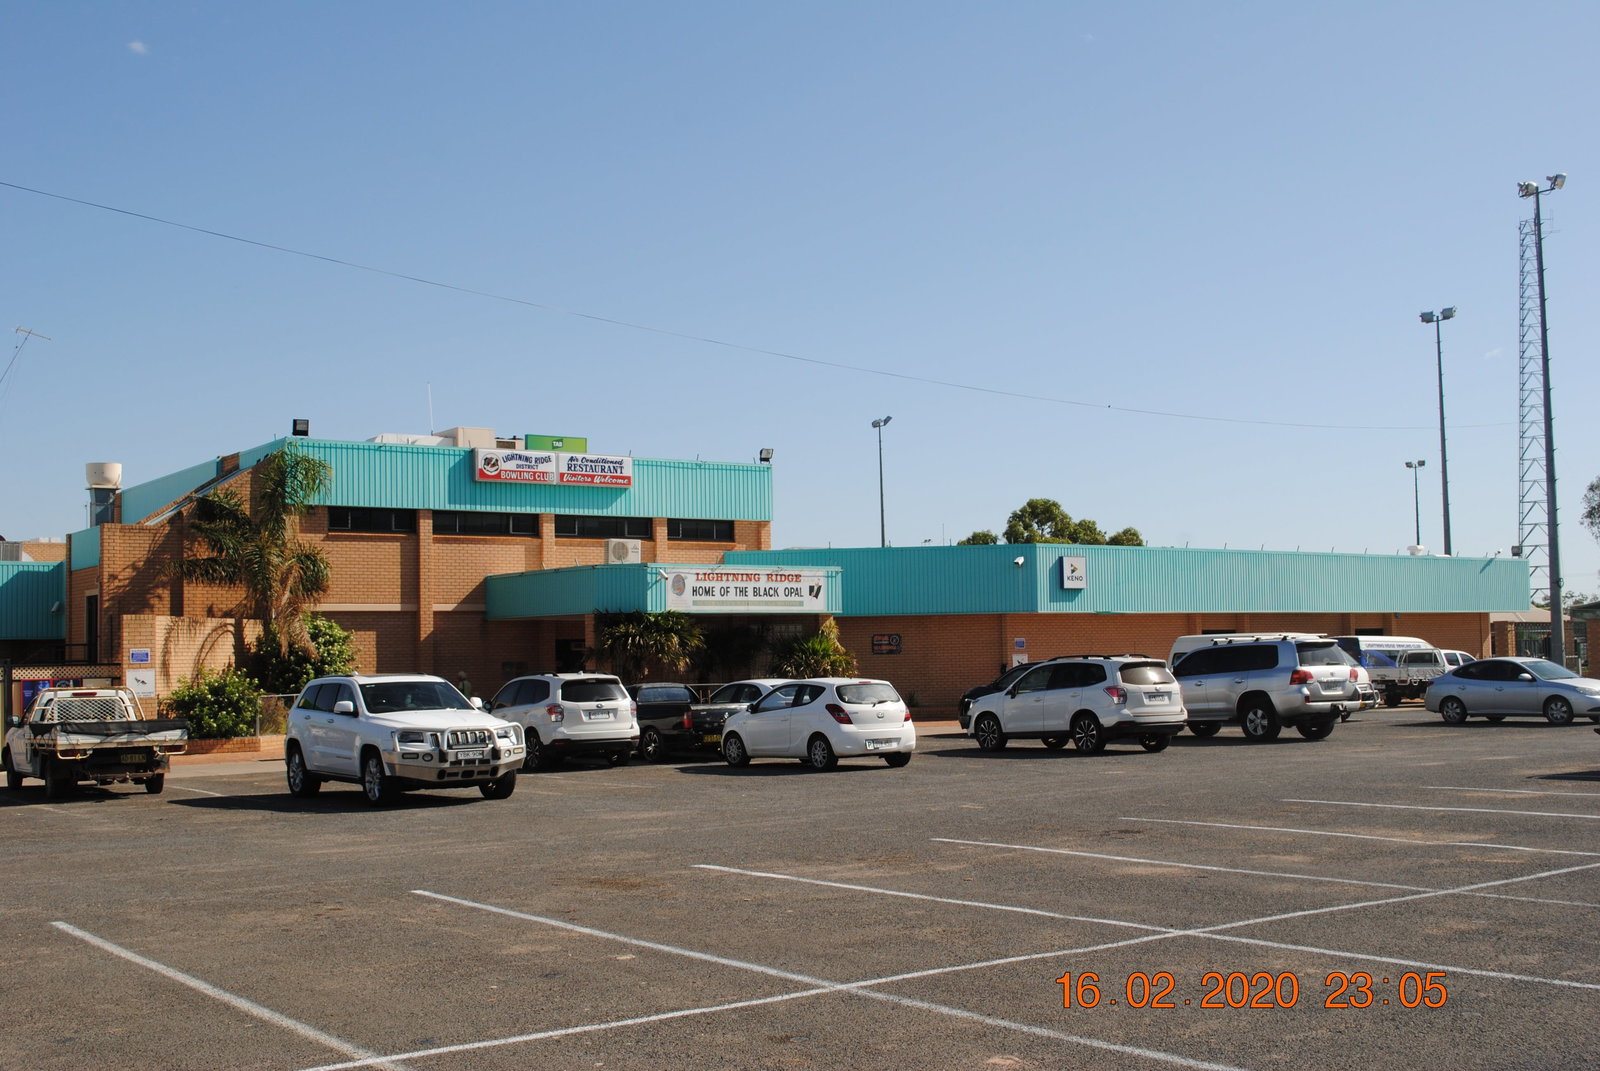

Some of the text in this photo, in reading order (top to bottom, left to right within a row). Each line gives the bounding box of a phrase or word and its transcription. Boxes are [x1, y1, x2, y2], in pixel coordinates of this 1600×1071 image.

[502, 453, 552, 465] LIGHTNING RIDGE
[580, 457, 624, 466] Conditioned
[566, 463, 624, 474] RESTAURANT
[501, 470, 554, 481] BOWLING CLUB
[563, 473, 629, 484] Visitors Welcome
[695, 572, 801, 583] LIGHTNING RIDGE
[692, 585, 804, 598] HOME OF THE BLACK OPAL
